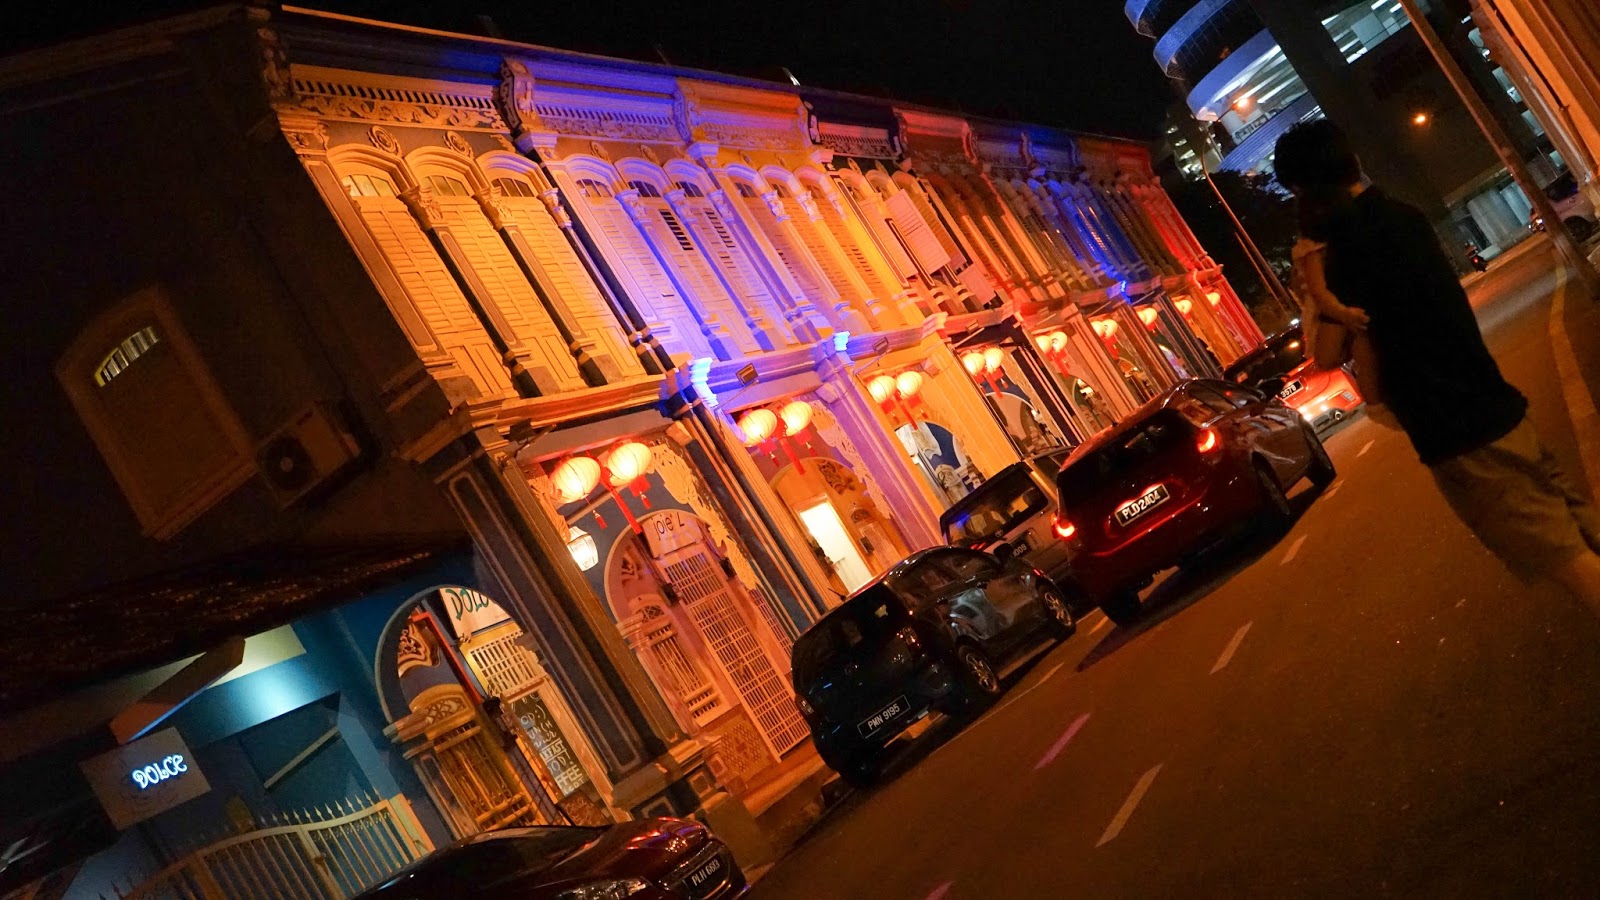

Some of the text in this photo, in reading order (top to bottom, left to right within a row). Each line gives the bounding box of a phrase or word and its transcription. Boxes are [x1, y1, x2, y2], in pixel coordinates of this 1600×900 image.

[867, 703, 901, 731] PMN 9195
[528, 720, 552, 740] UNCH
[132, 754, 188, 789] DOLCE
[555, 764, 583, 787] FFEE
